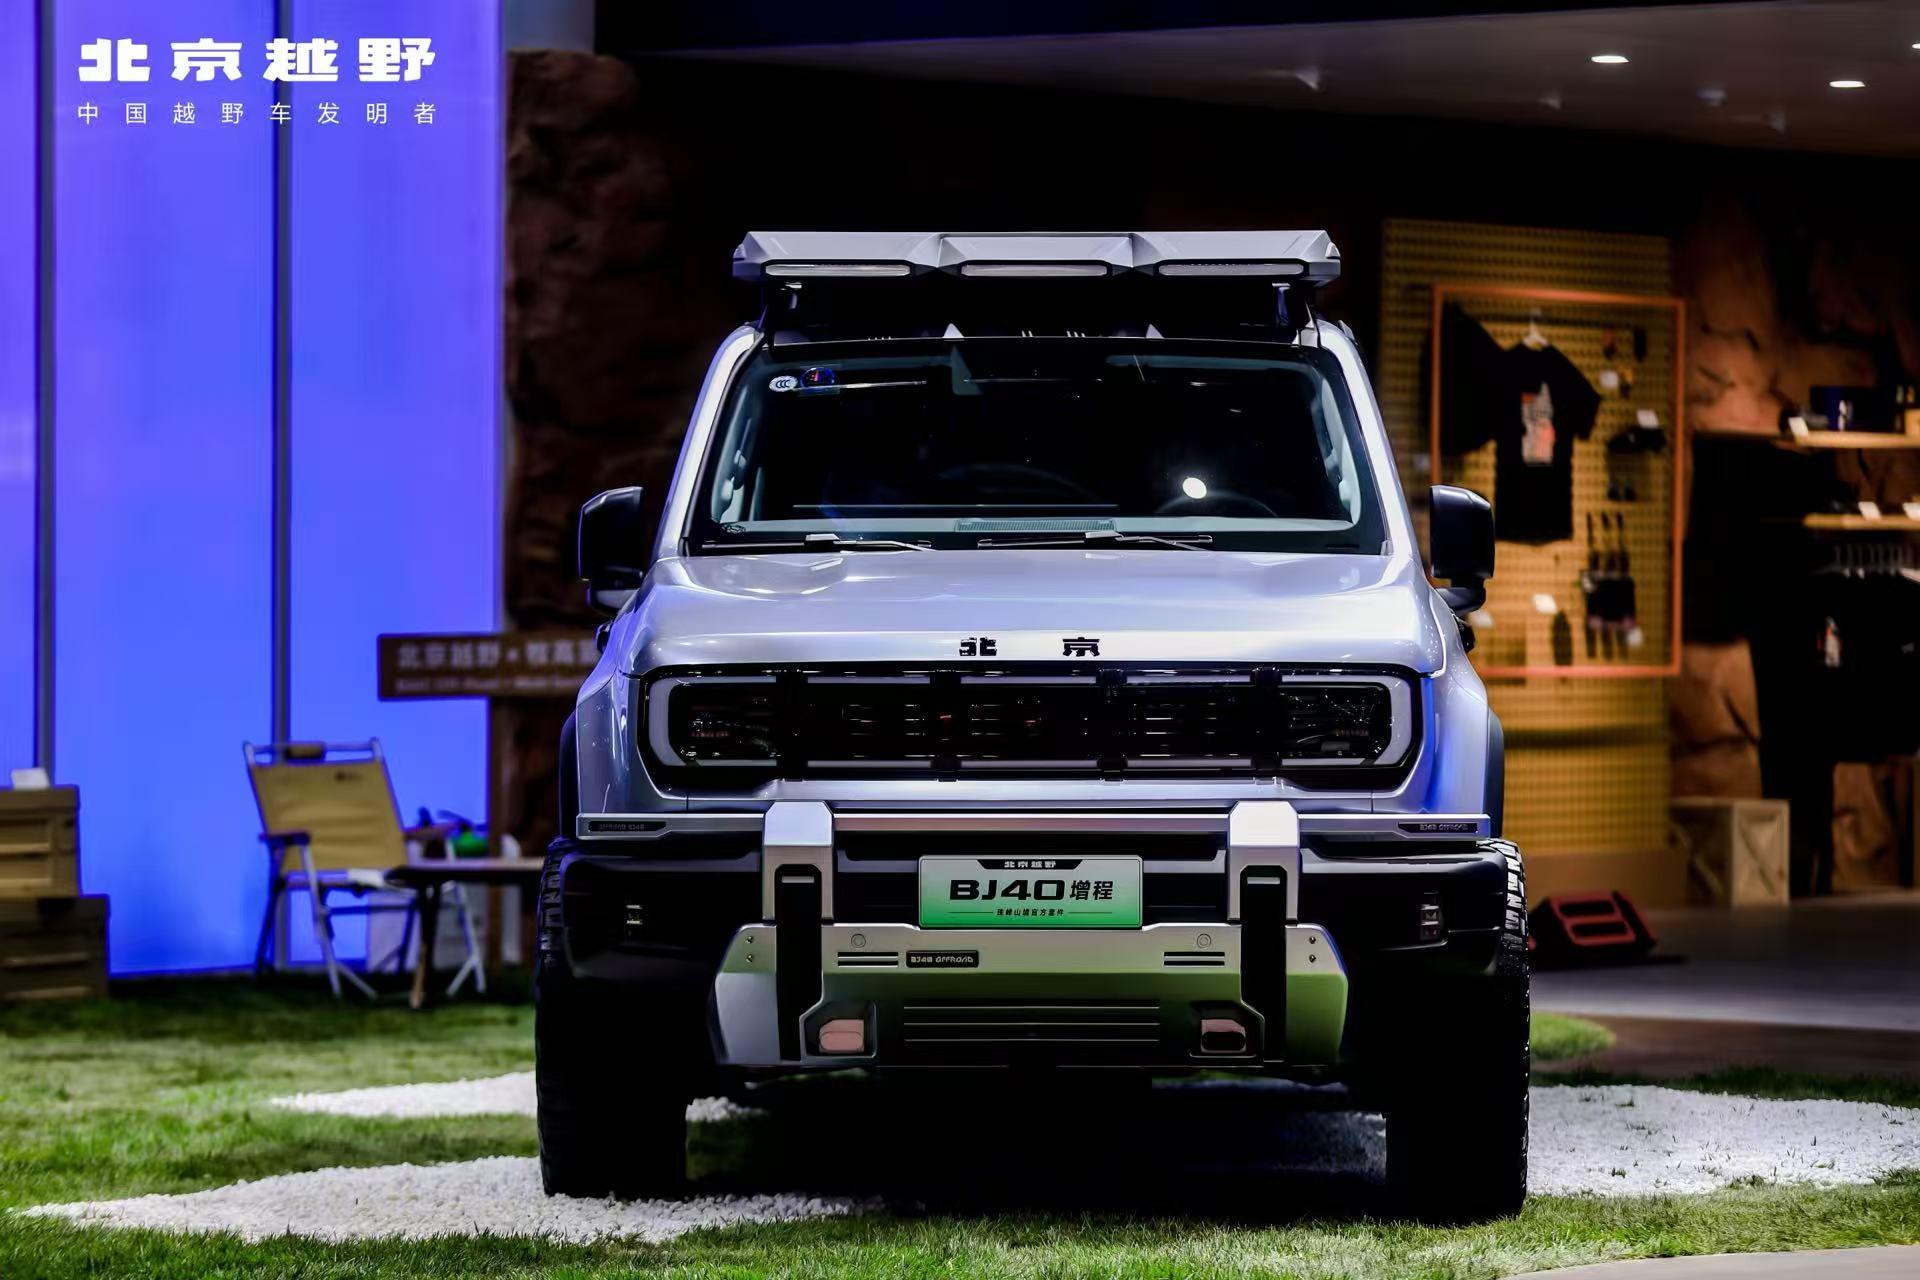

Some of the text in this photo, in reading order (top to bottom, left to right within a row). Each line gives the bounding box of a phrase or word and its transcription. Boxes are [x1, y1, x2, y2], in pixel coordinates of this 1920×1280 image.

[958, 636, 1100, 658] 北京
[1003, 860, 1057, 869] 北京越野
[949, 879, 1114, 902] BJ40 增程
